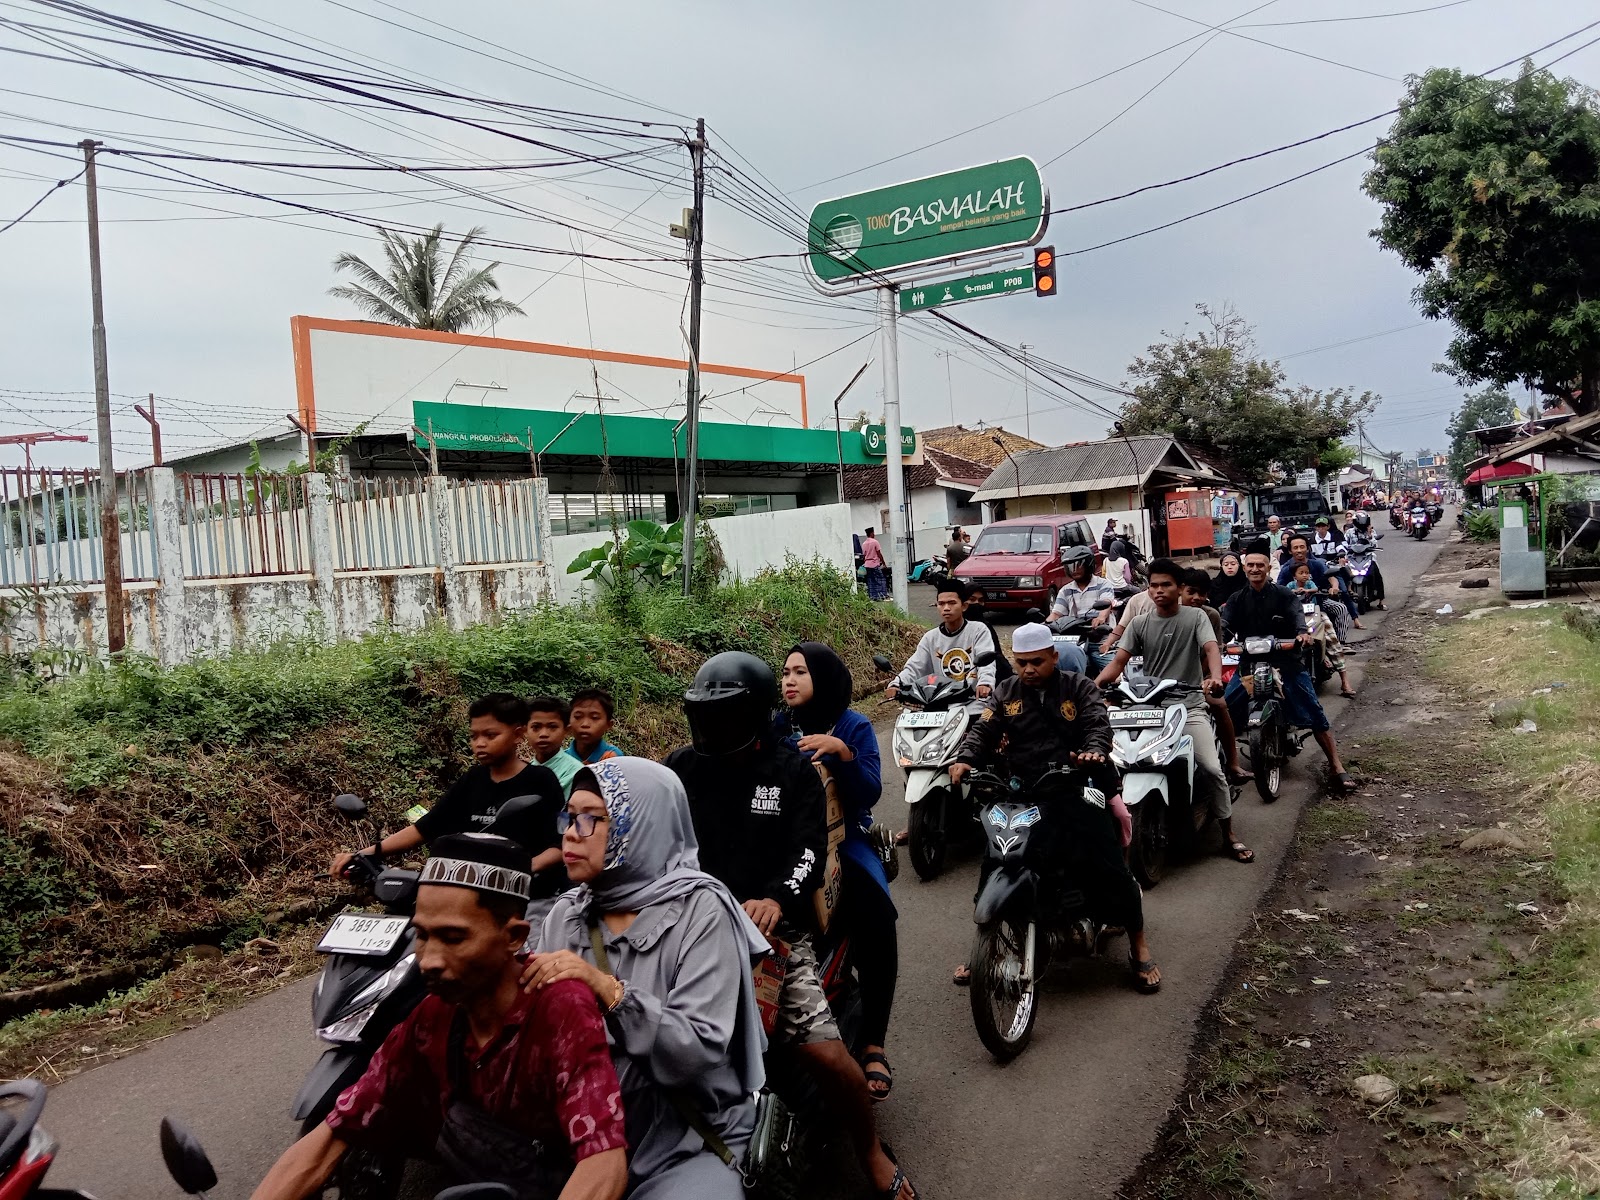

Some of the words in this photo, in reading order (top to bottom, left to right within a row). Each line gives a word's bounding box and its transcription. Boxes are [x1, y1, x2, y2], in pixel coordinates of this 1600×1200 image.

[867, 214, 891, 231] TOKO
[890, 181, 1025, 235] BASMALAH
[940, 220, 964, 232] tempat
[965, 215, 991, 226] belanja
[992, 211, 1010, 223] yang
[1010, 207, 1026, 217] baik
[1003, 276, 1022, 287] PPOB
[432, 432, 469, 441] WANGKAL
[348, 920, 380, 933] 3897
[360, 938, 391, 948] 11-29
